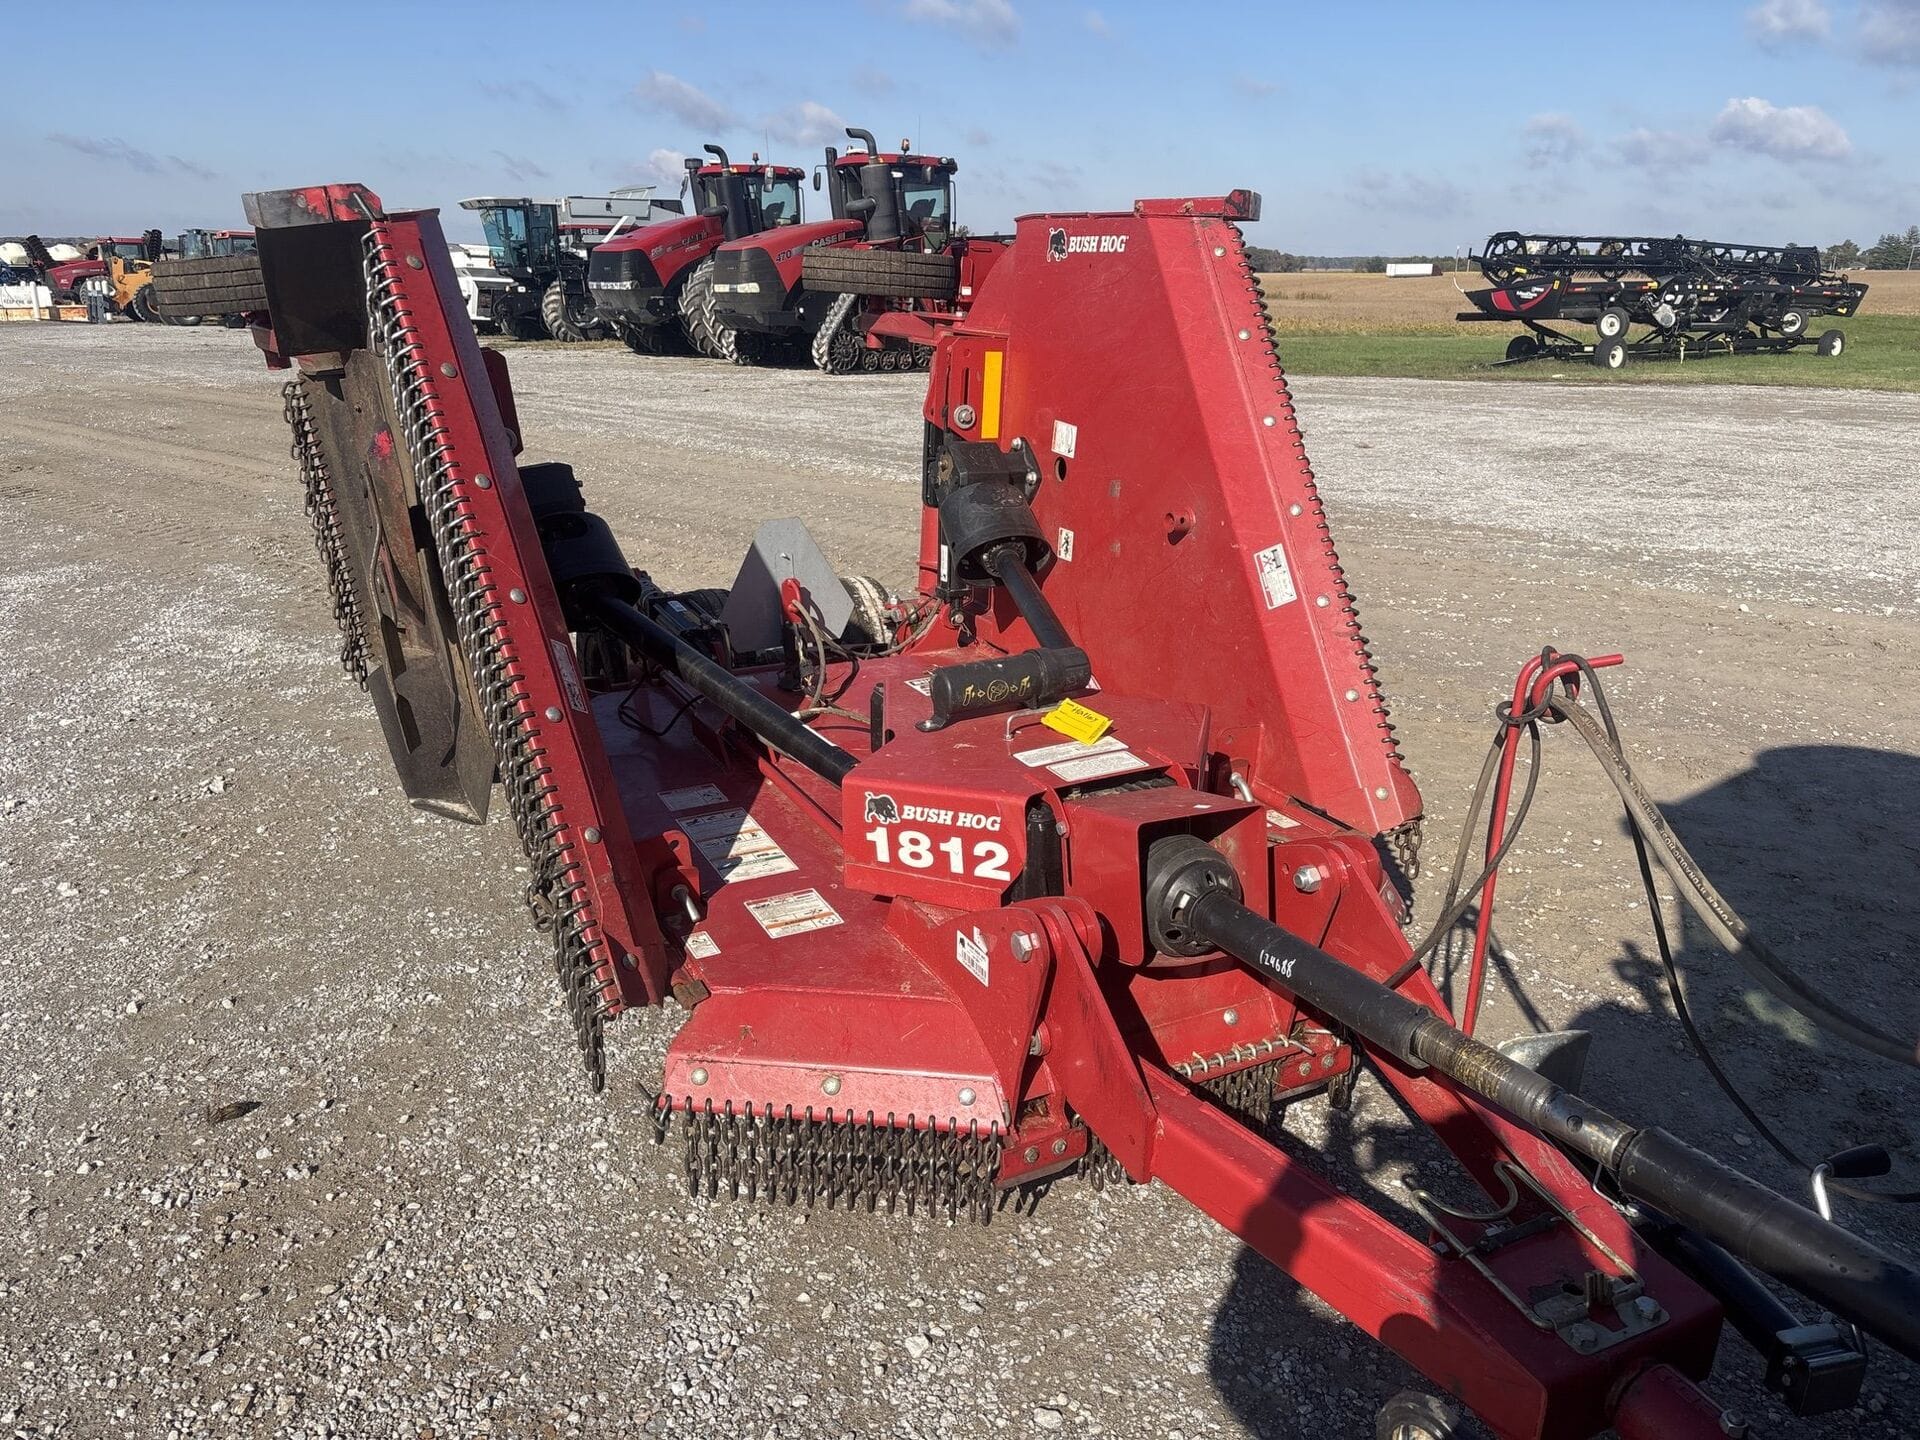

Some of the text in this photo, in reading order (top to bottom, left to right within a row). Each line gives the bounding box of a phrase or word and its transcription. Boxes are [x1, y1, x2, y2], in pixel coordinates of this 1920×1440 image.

[812, 235, 838, 248] CASE
[1067, 235, 1127, 252] BUSH HOG
[775, 250, 792, 263] 470
[901, 805, 1001, 831] BUSH HOG
[1660, 829, 1677, 851] HOSE
[865, 826, 1011, 881] 1812
[1673, 850, 1707, 895] HYDRAULIC
[1708, 896, 1734, 927] POWER
[1259, 949, 1297, 978] 124688
